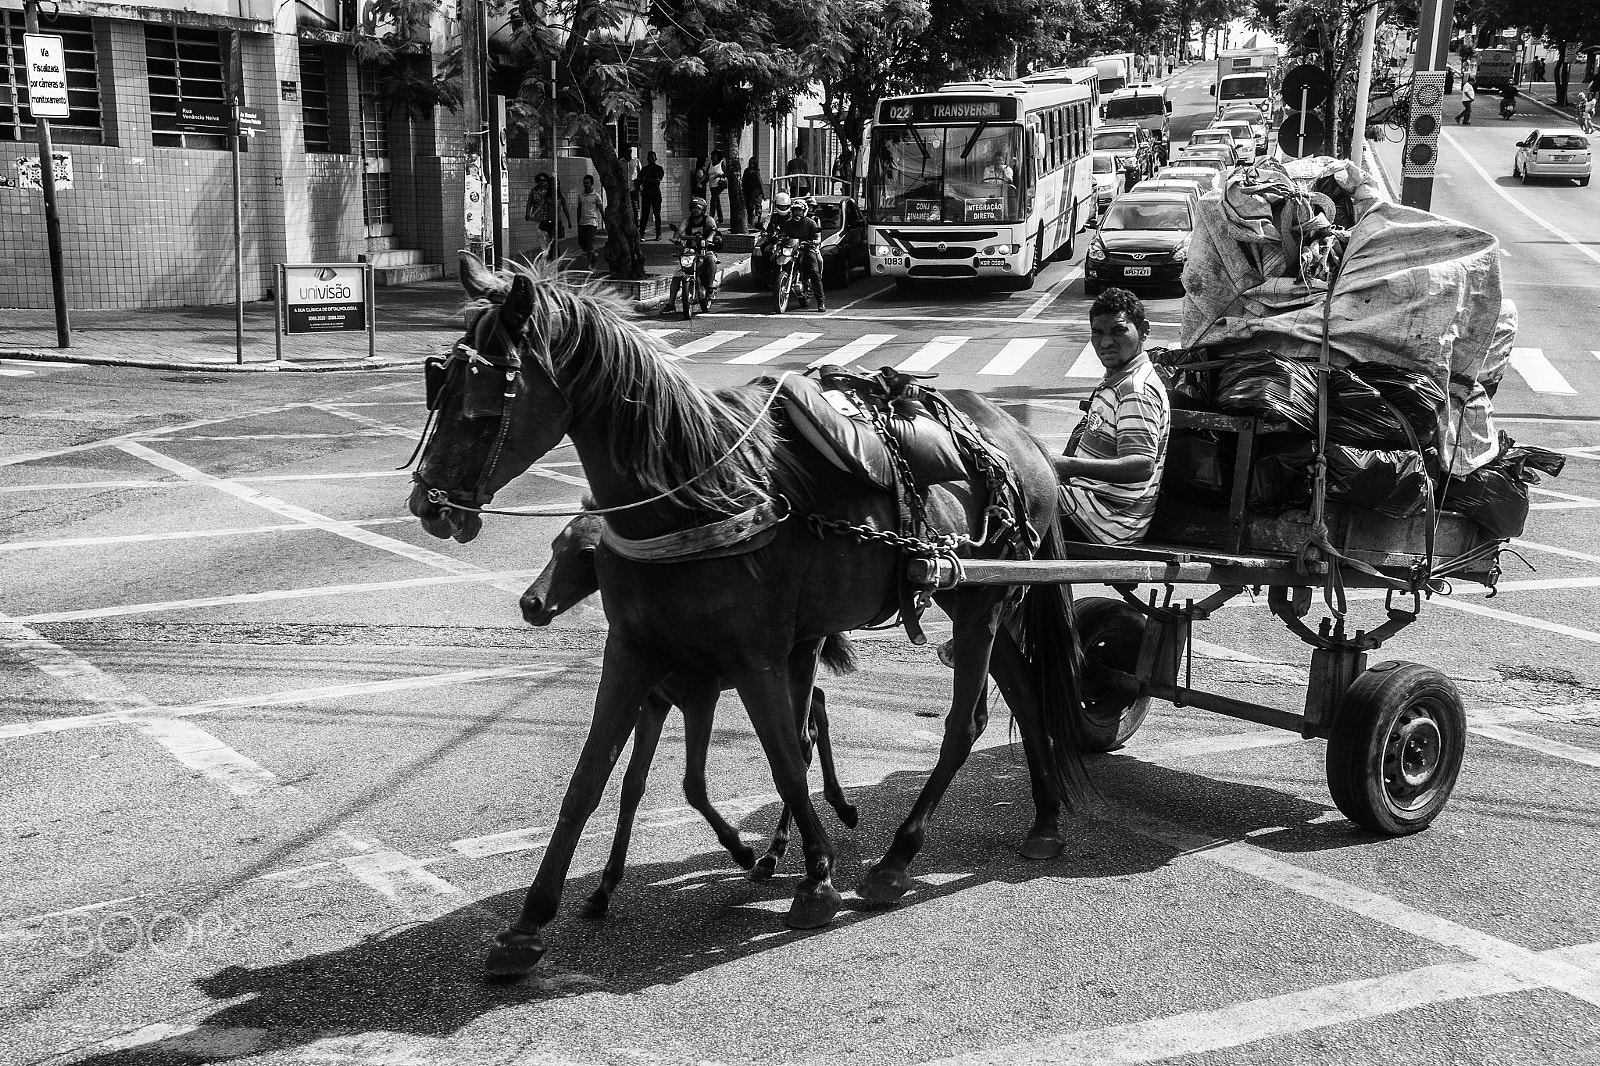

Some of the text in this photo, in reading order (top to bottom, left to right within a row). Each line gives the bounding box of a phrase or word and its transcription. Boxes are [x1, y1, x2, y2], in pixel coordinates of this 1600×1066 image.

[33, 63, 60, 73] Fiscalizada
[59, 80, 65, 88] de
[890, 102, 1000, 119] 022 TRANSVERSAL
[973, 212, 995, 220] DIRETO
[883, 257, 903, 266] 1083
[299, 283, 351, 300] univisão
